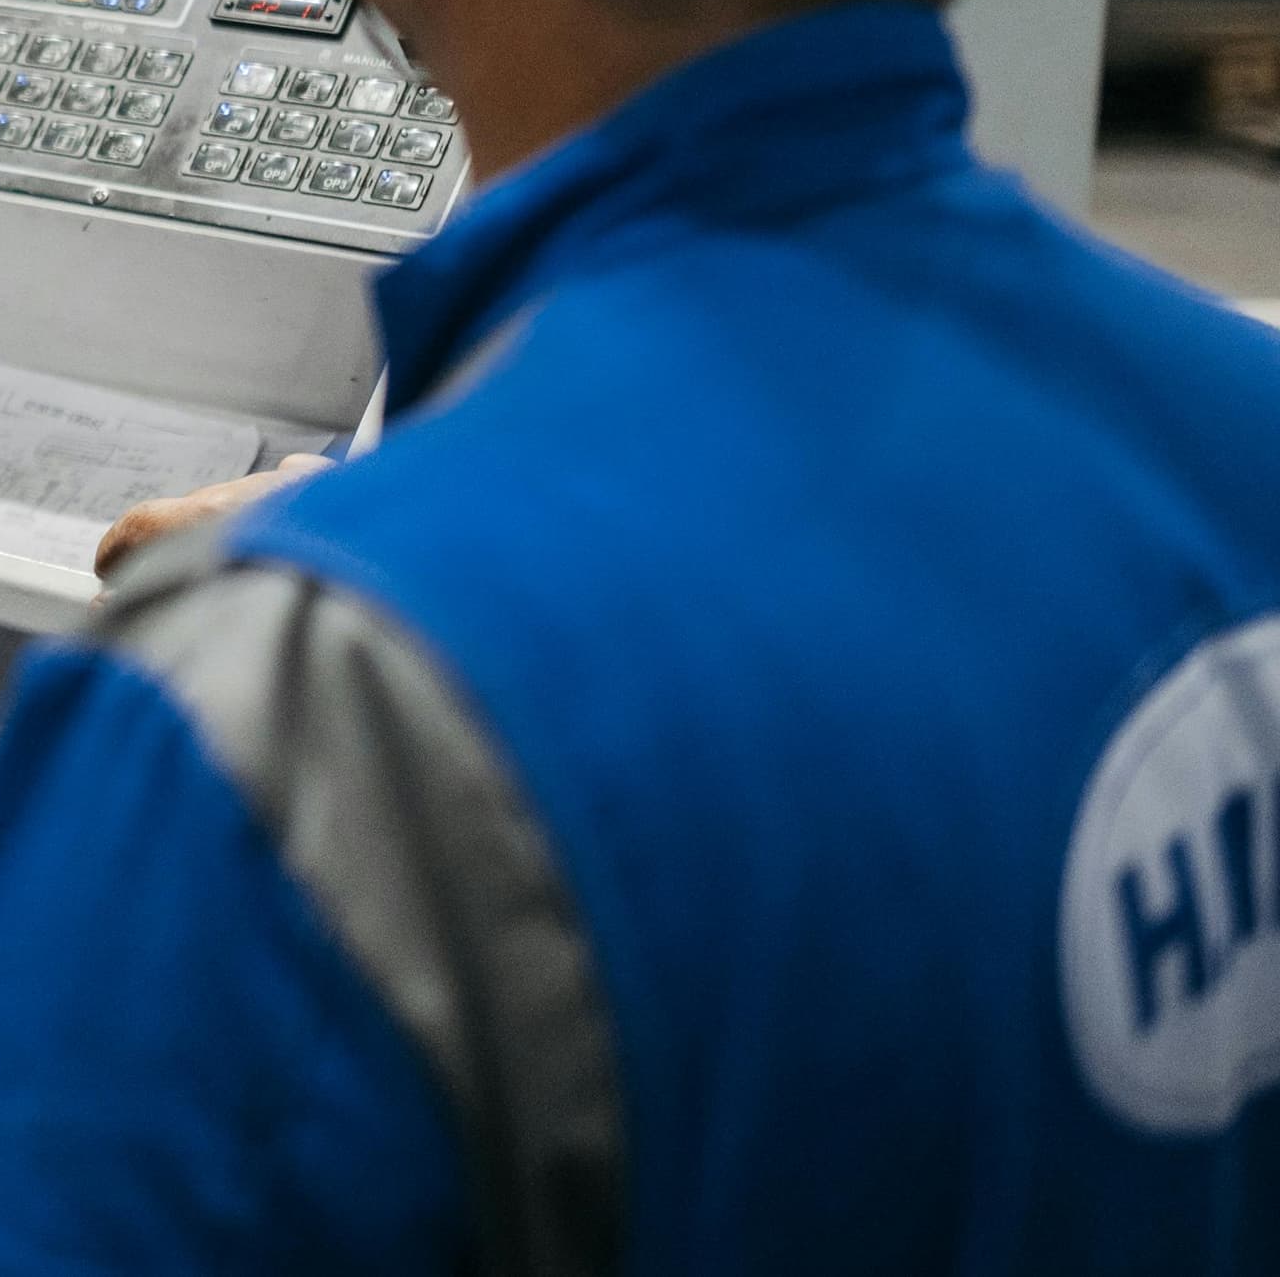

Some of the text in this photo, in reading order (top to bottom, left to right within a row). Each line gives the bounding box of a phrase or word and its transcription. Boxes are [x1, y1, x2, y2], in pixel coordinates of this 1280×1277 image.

[343, 53, 393, 70] MANUAL
[204, 160, 228, 172] OP1
[263, 168, 287, 181] OP2
[323, 177, 348, 190] OP3
